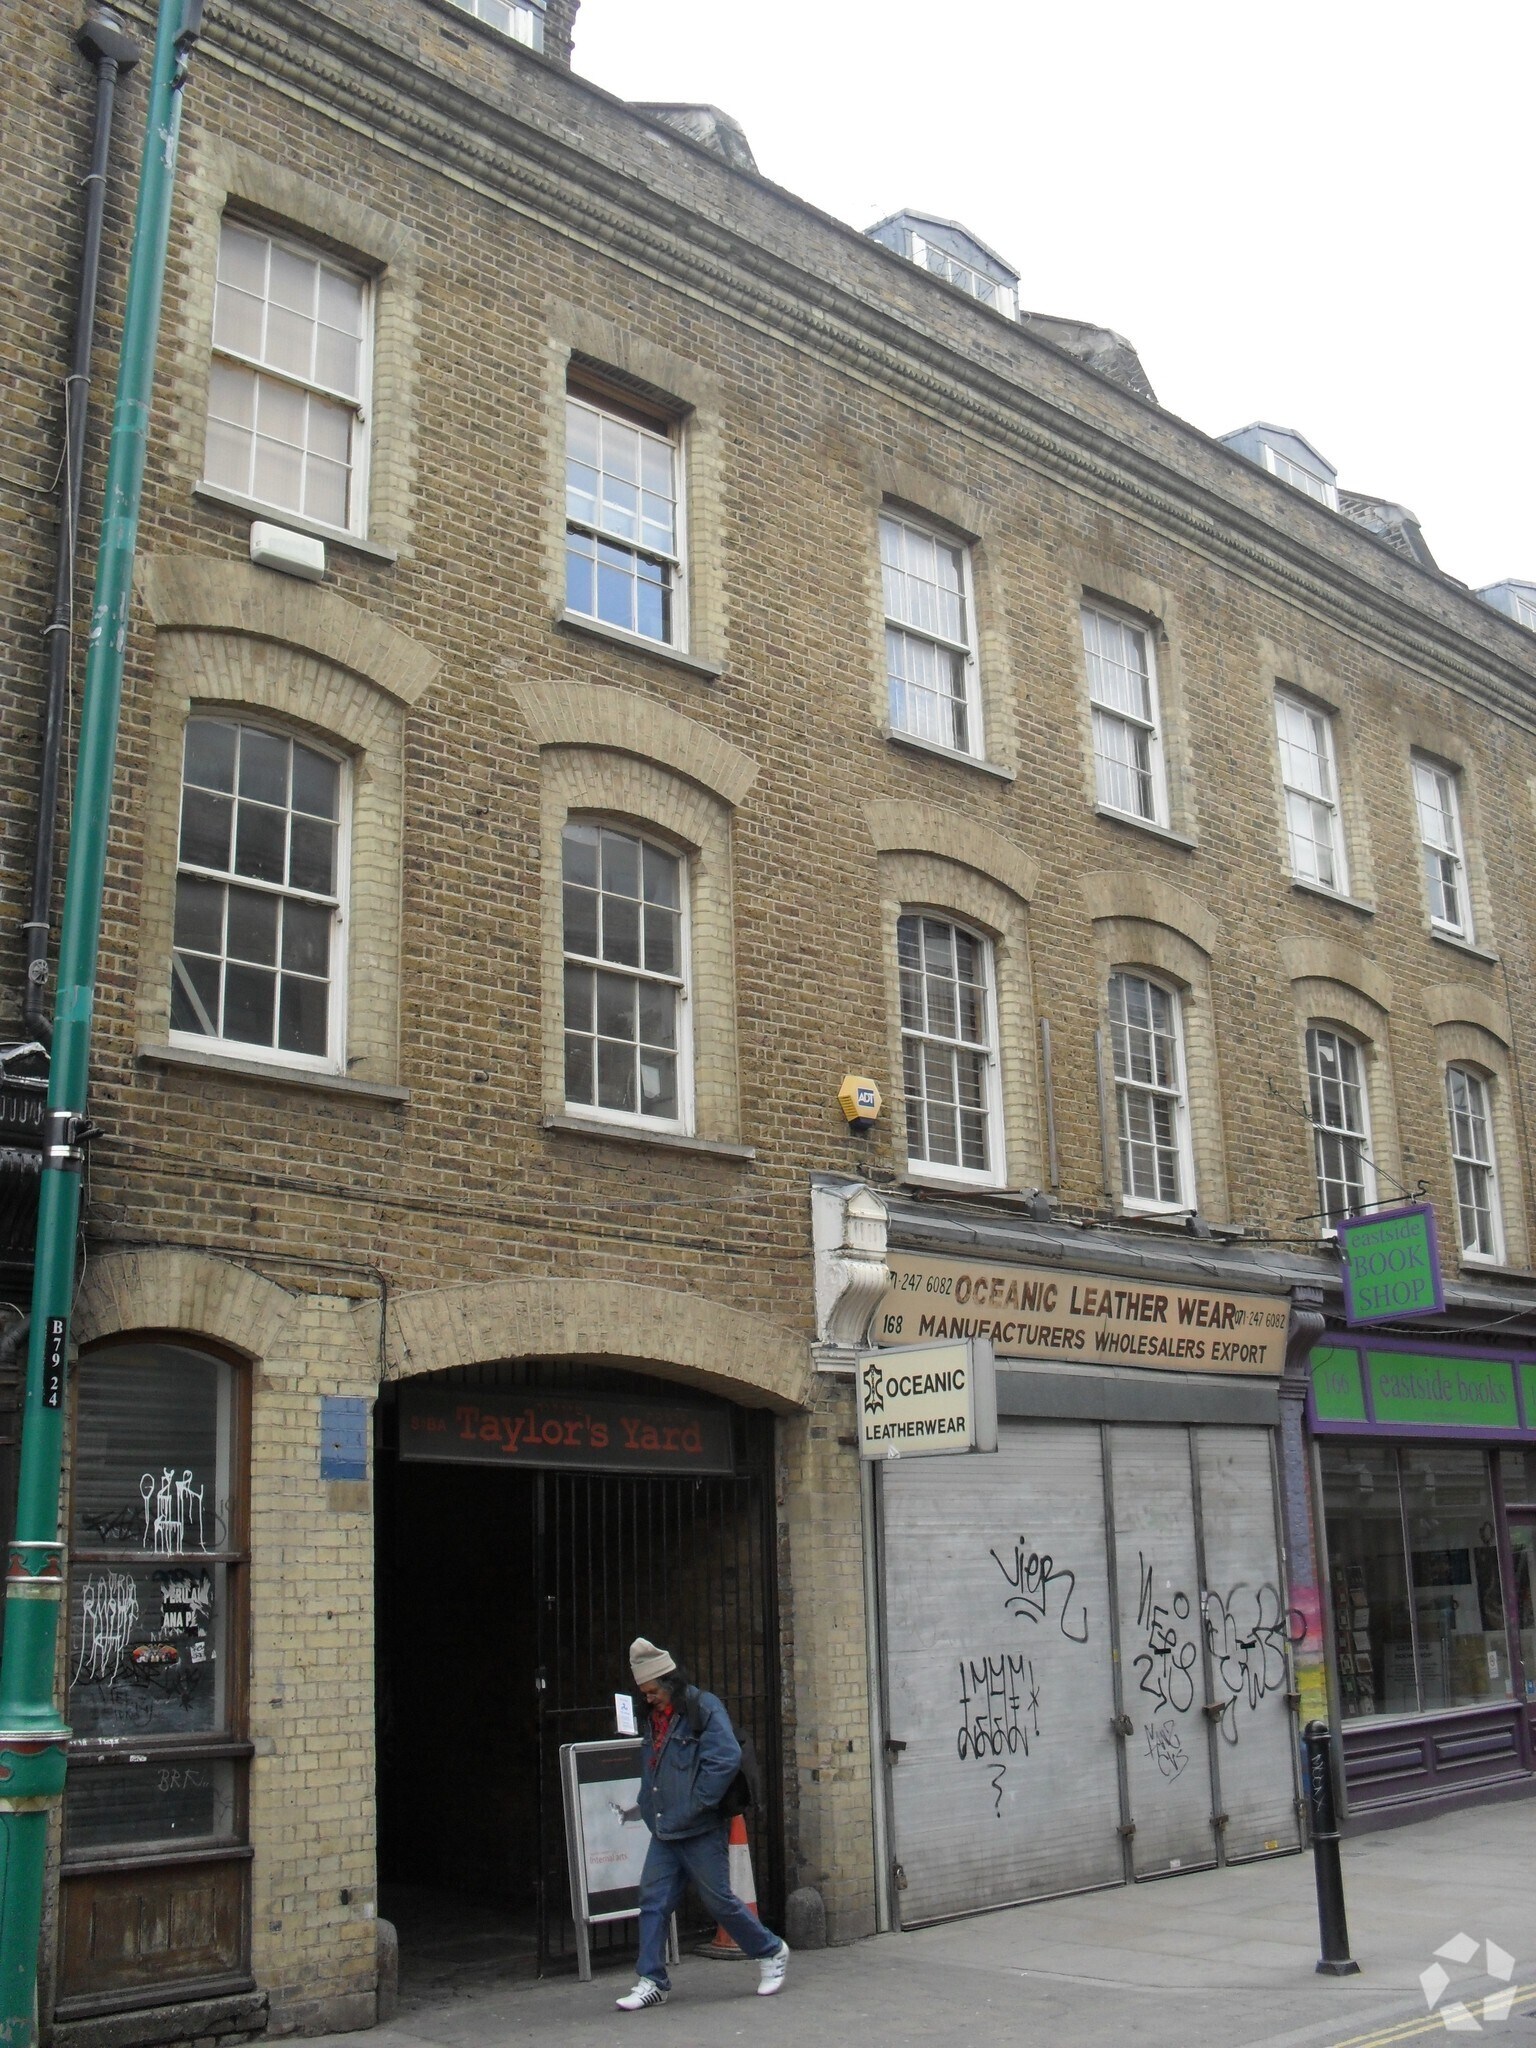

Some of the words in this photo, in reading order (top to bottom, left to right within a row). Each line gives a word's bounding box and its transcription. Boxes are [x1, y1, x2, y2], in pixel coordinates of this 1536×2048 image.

[857, 1091, 875, 1104] ADT
[1352, 1220, 1420, 1248] eastside
[1354, 1244, 1425, 1279] BOOK
[926, 1275, 953, 1295] 6082
[1358, 1279, 1425, 1310] SHOP
[954, 1274, 1058, 1313] OCEANIC
[1069, 1285, 1169, 1324] LEATHER
[1177, 1297, 1235, 1330] WEAR
[883, 1314, 904, 1334] 168
[1265, 1312, 1286, 1329] 6082
[918, 1314, 1086, 1350] MANUFACTURERS
[1095, 1331, 1205, 1360] WHOLESALERS
[1211, 1341, 1267, 1364] EXPORT
[886, 1369, 965, 1398] OCEANIC
[1379, 1368, 1452, 1402] eastside
[1456, 1370, 1507, 1404] books
[455, 1405, 609, 1453] Taylor's
[620, 1417, 703, 1453] Yard
[866, 1416, 966, 1441] LEATHERWEAR
[589, 1853, 615, 1864] Internal
[615, 1852, 628, 1862] arts
